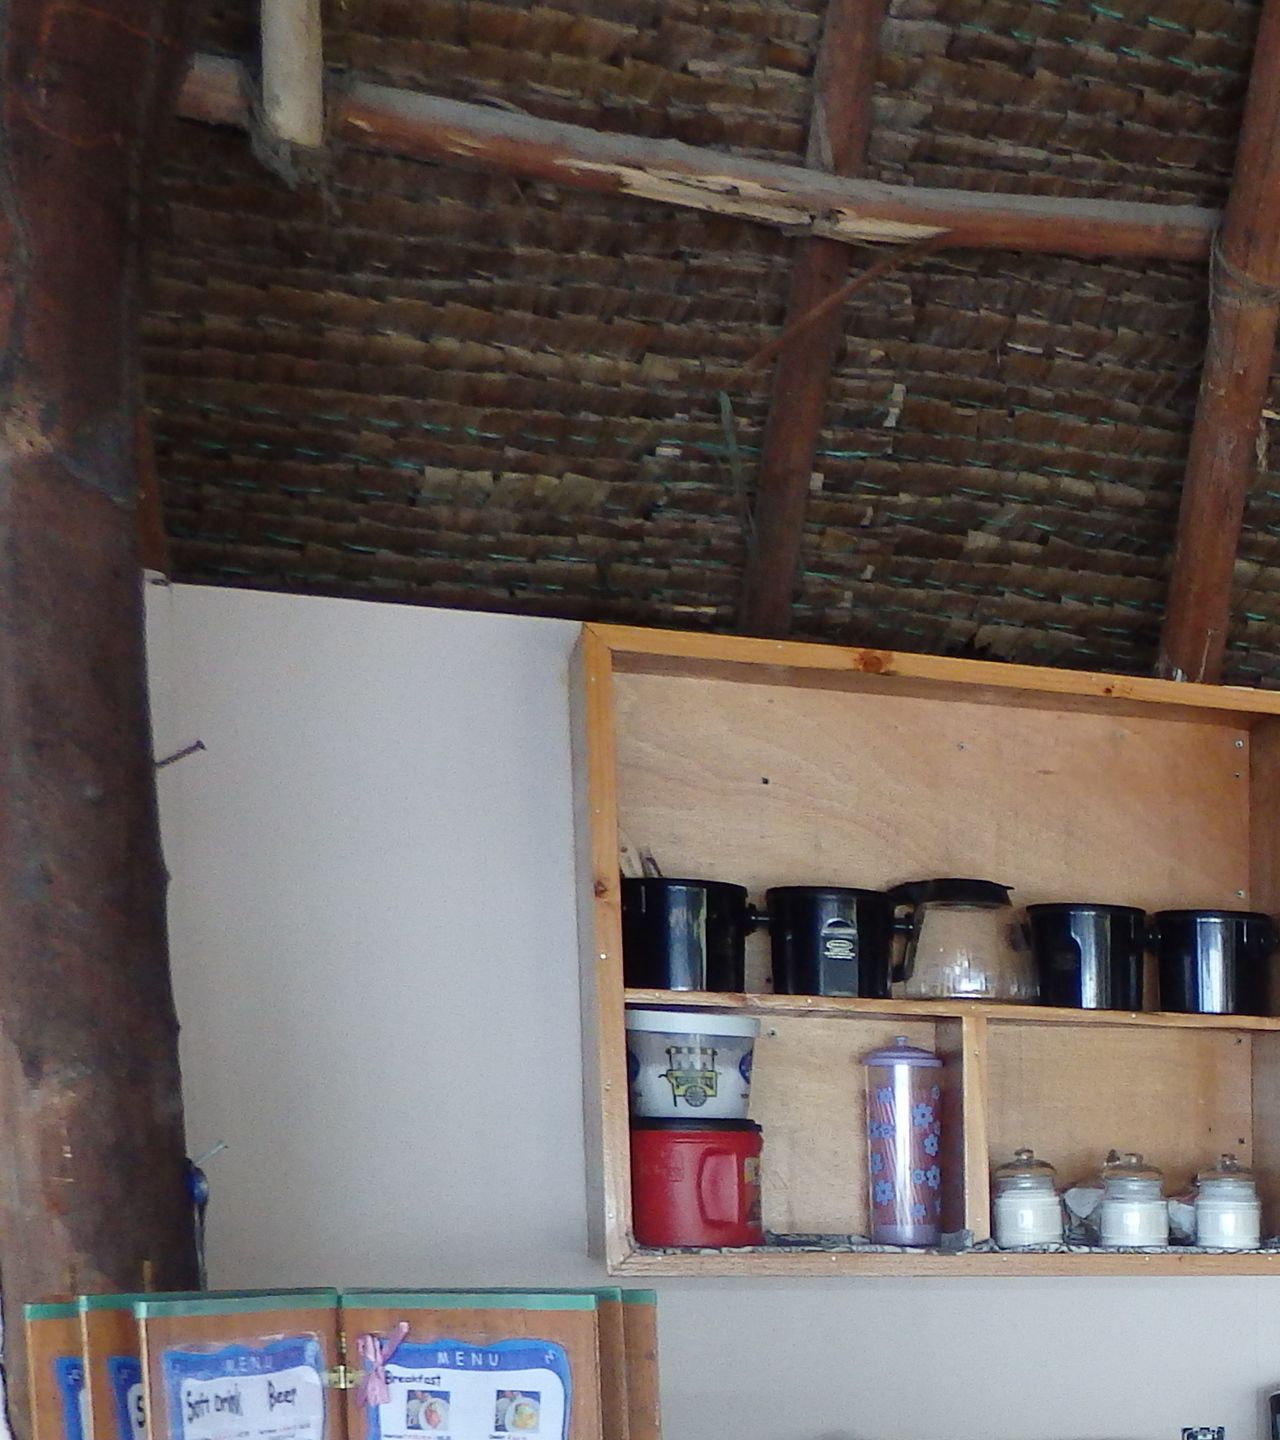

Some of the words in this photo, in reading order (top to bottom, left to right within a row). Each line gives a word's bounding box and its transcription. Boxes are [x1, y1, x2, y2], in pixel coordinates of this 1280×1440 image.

[436, 1351, 500, 1367] MENU
[385, 1370, 441, 1387] Breakfast
[267, 1380, 297, 1412] Beer
